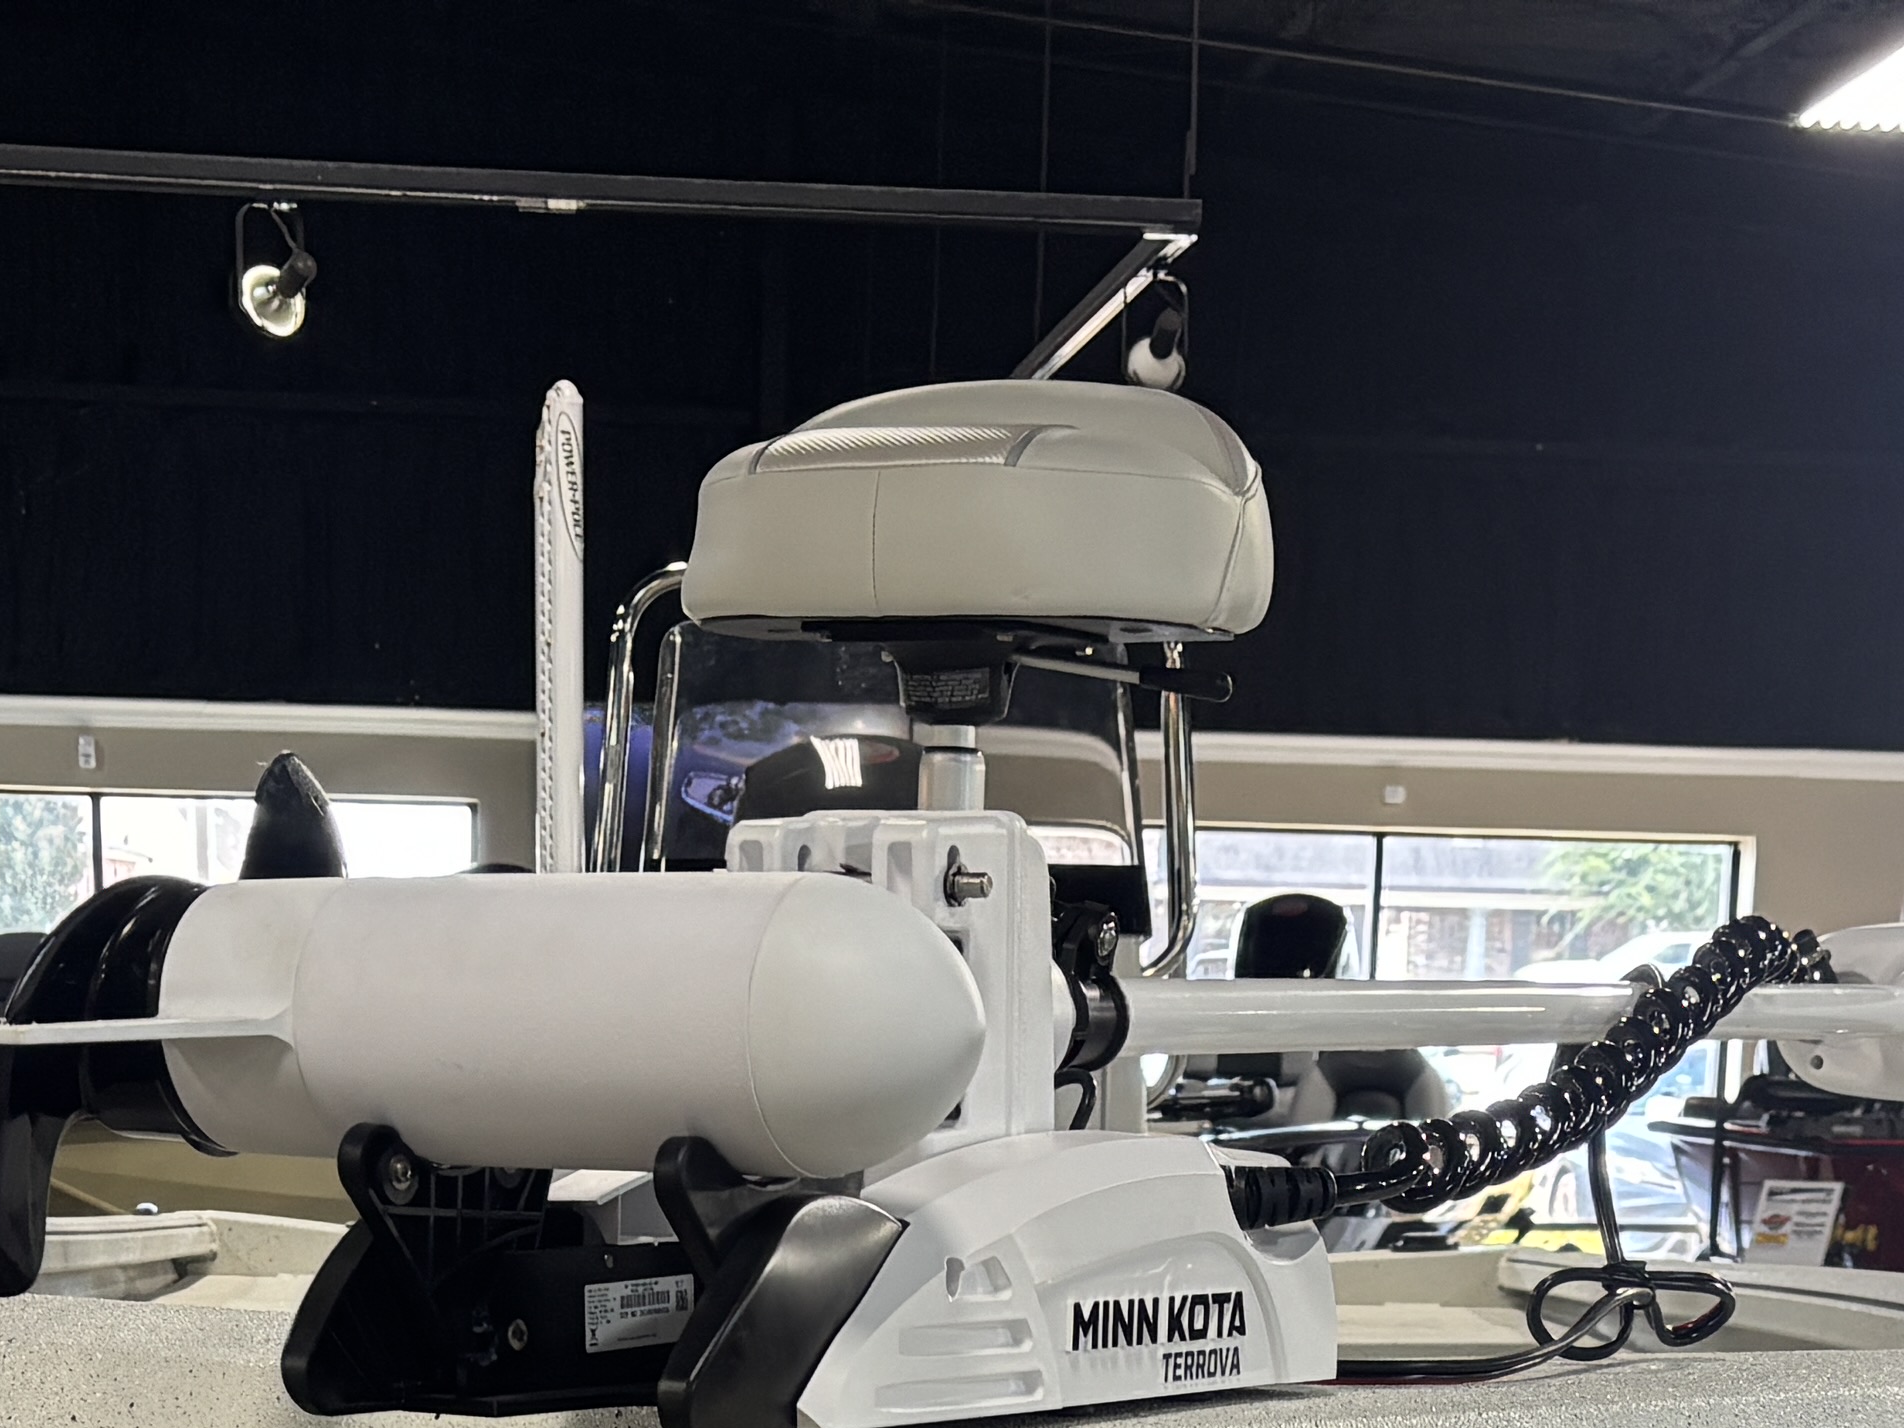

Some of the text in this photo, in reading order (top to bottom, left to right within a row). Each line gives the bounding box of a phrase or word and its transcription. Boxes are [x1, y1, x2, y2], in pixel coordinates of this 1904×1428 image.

[1071, 1290, 1246, 1352] MINN KOTA
[1162, 1346, 1241, 1383] TERROVA
